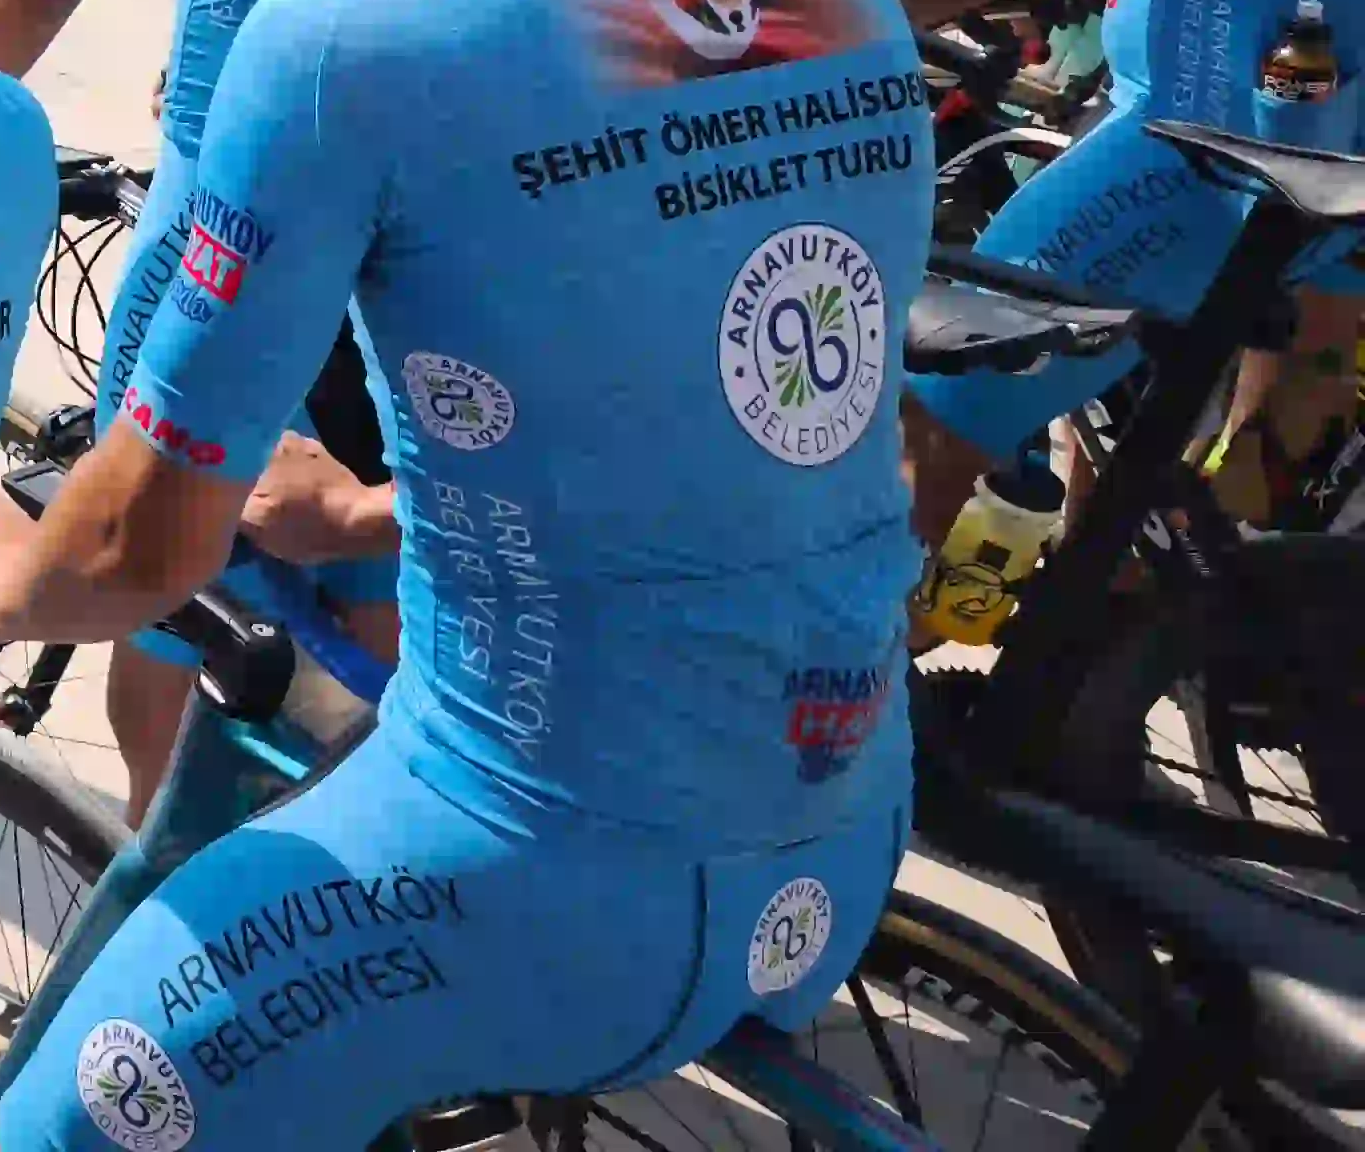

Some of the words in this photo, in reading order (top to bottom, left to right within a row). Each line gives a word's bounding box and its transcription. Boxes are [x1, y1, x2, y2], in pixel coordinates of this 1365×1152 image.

[512, 125, 649, 200] ŞEHİT
[660, 104, 771, 156] ÖMER
[773, 70, 926, 133] HALİSDE
[654, 150, 809, 221] BİSİKLET
[813, 133, 913, 185] TURU
[727, 235, 878, 348] ARNAVUTKÖY
[157, 864, 466, 1026] ARNAVUTKÖY
[191, 936, 447, 1088] BELEDİYESİ
